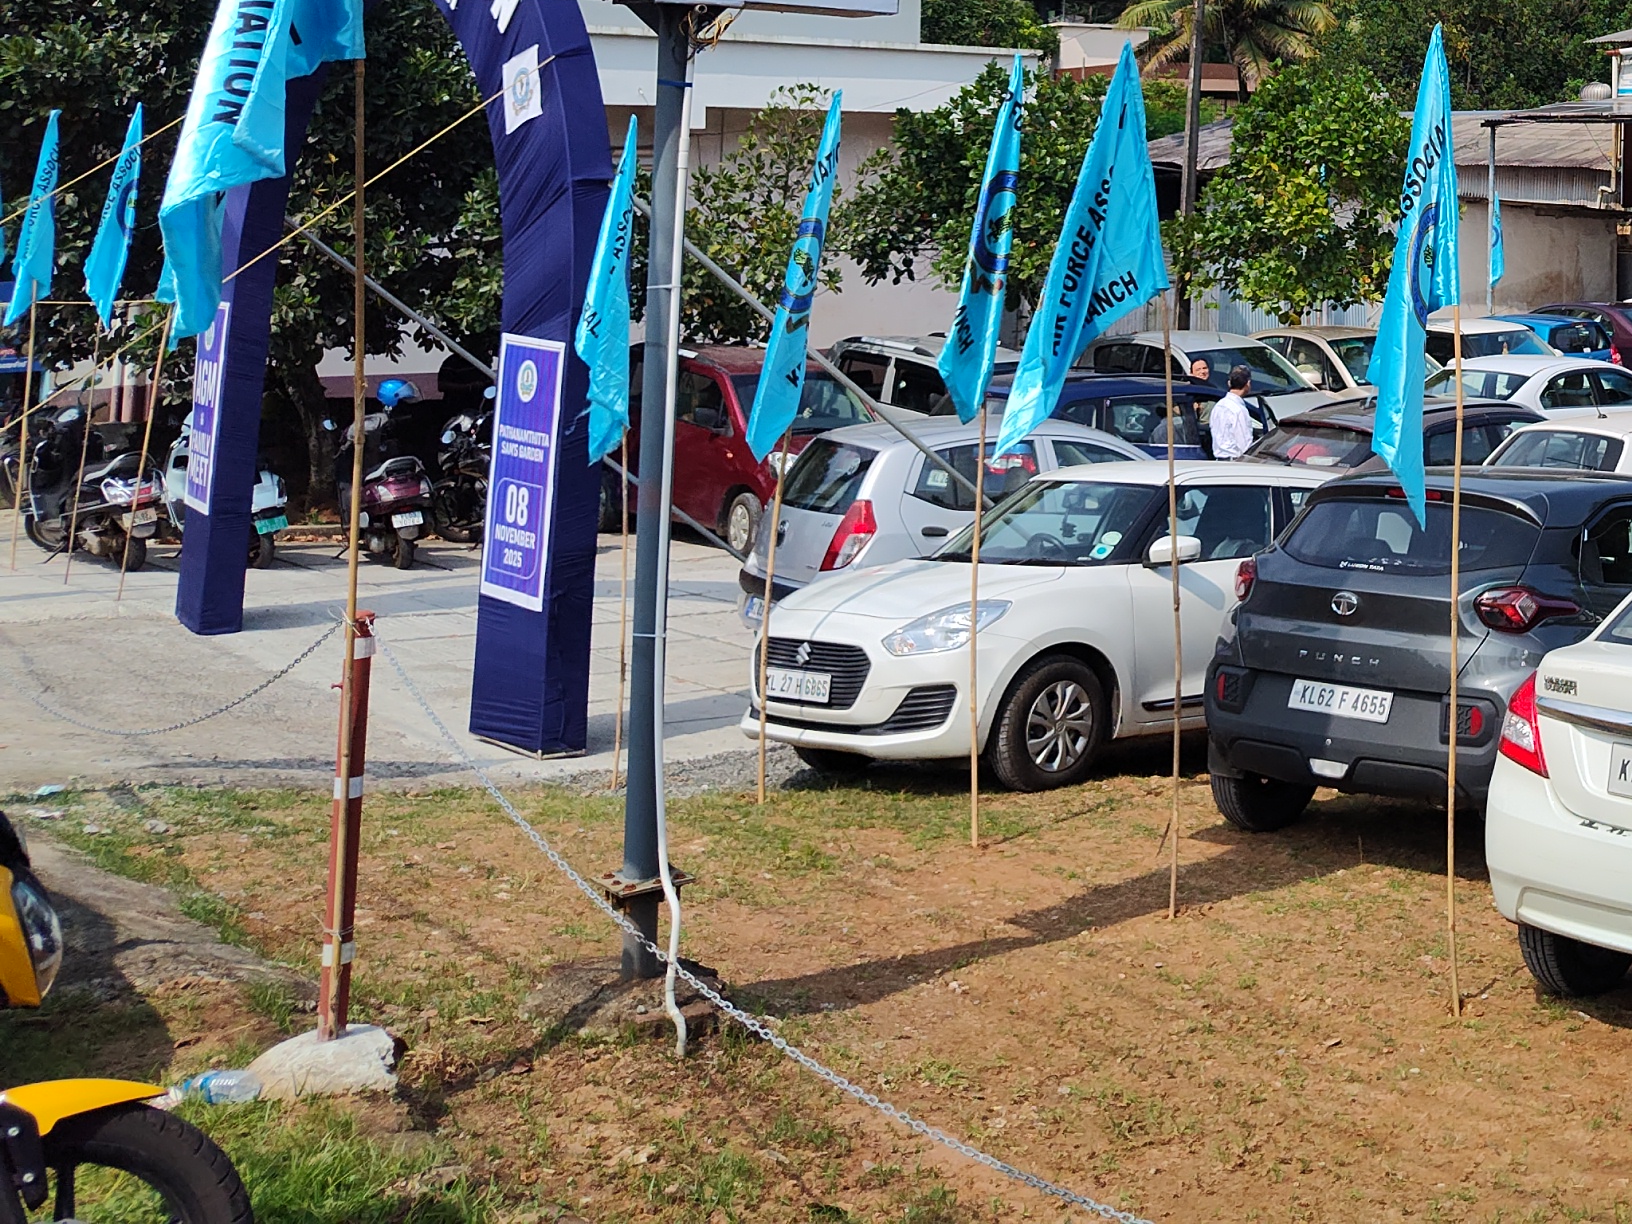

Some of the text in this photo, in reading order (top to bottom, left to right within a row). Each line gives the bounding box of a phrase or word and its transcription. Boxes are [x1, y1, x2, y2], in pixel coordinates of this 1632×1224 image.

[197, 359, 218, 409] AGM
[190, 451, 209, 487] MEET
[506, 484, 529, 526] 08
[494, 523, 536, 550] NOVEMBER
[503, 547, 523, 569] 2025
[1299, 649, 1380, 668] PUNCH
[780, 674, 793, 693] 27
[1299, 684, 1388, 716] KL62 F 4655
